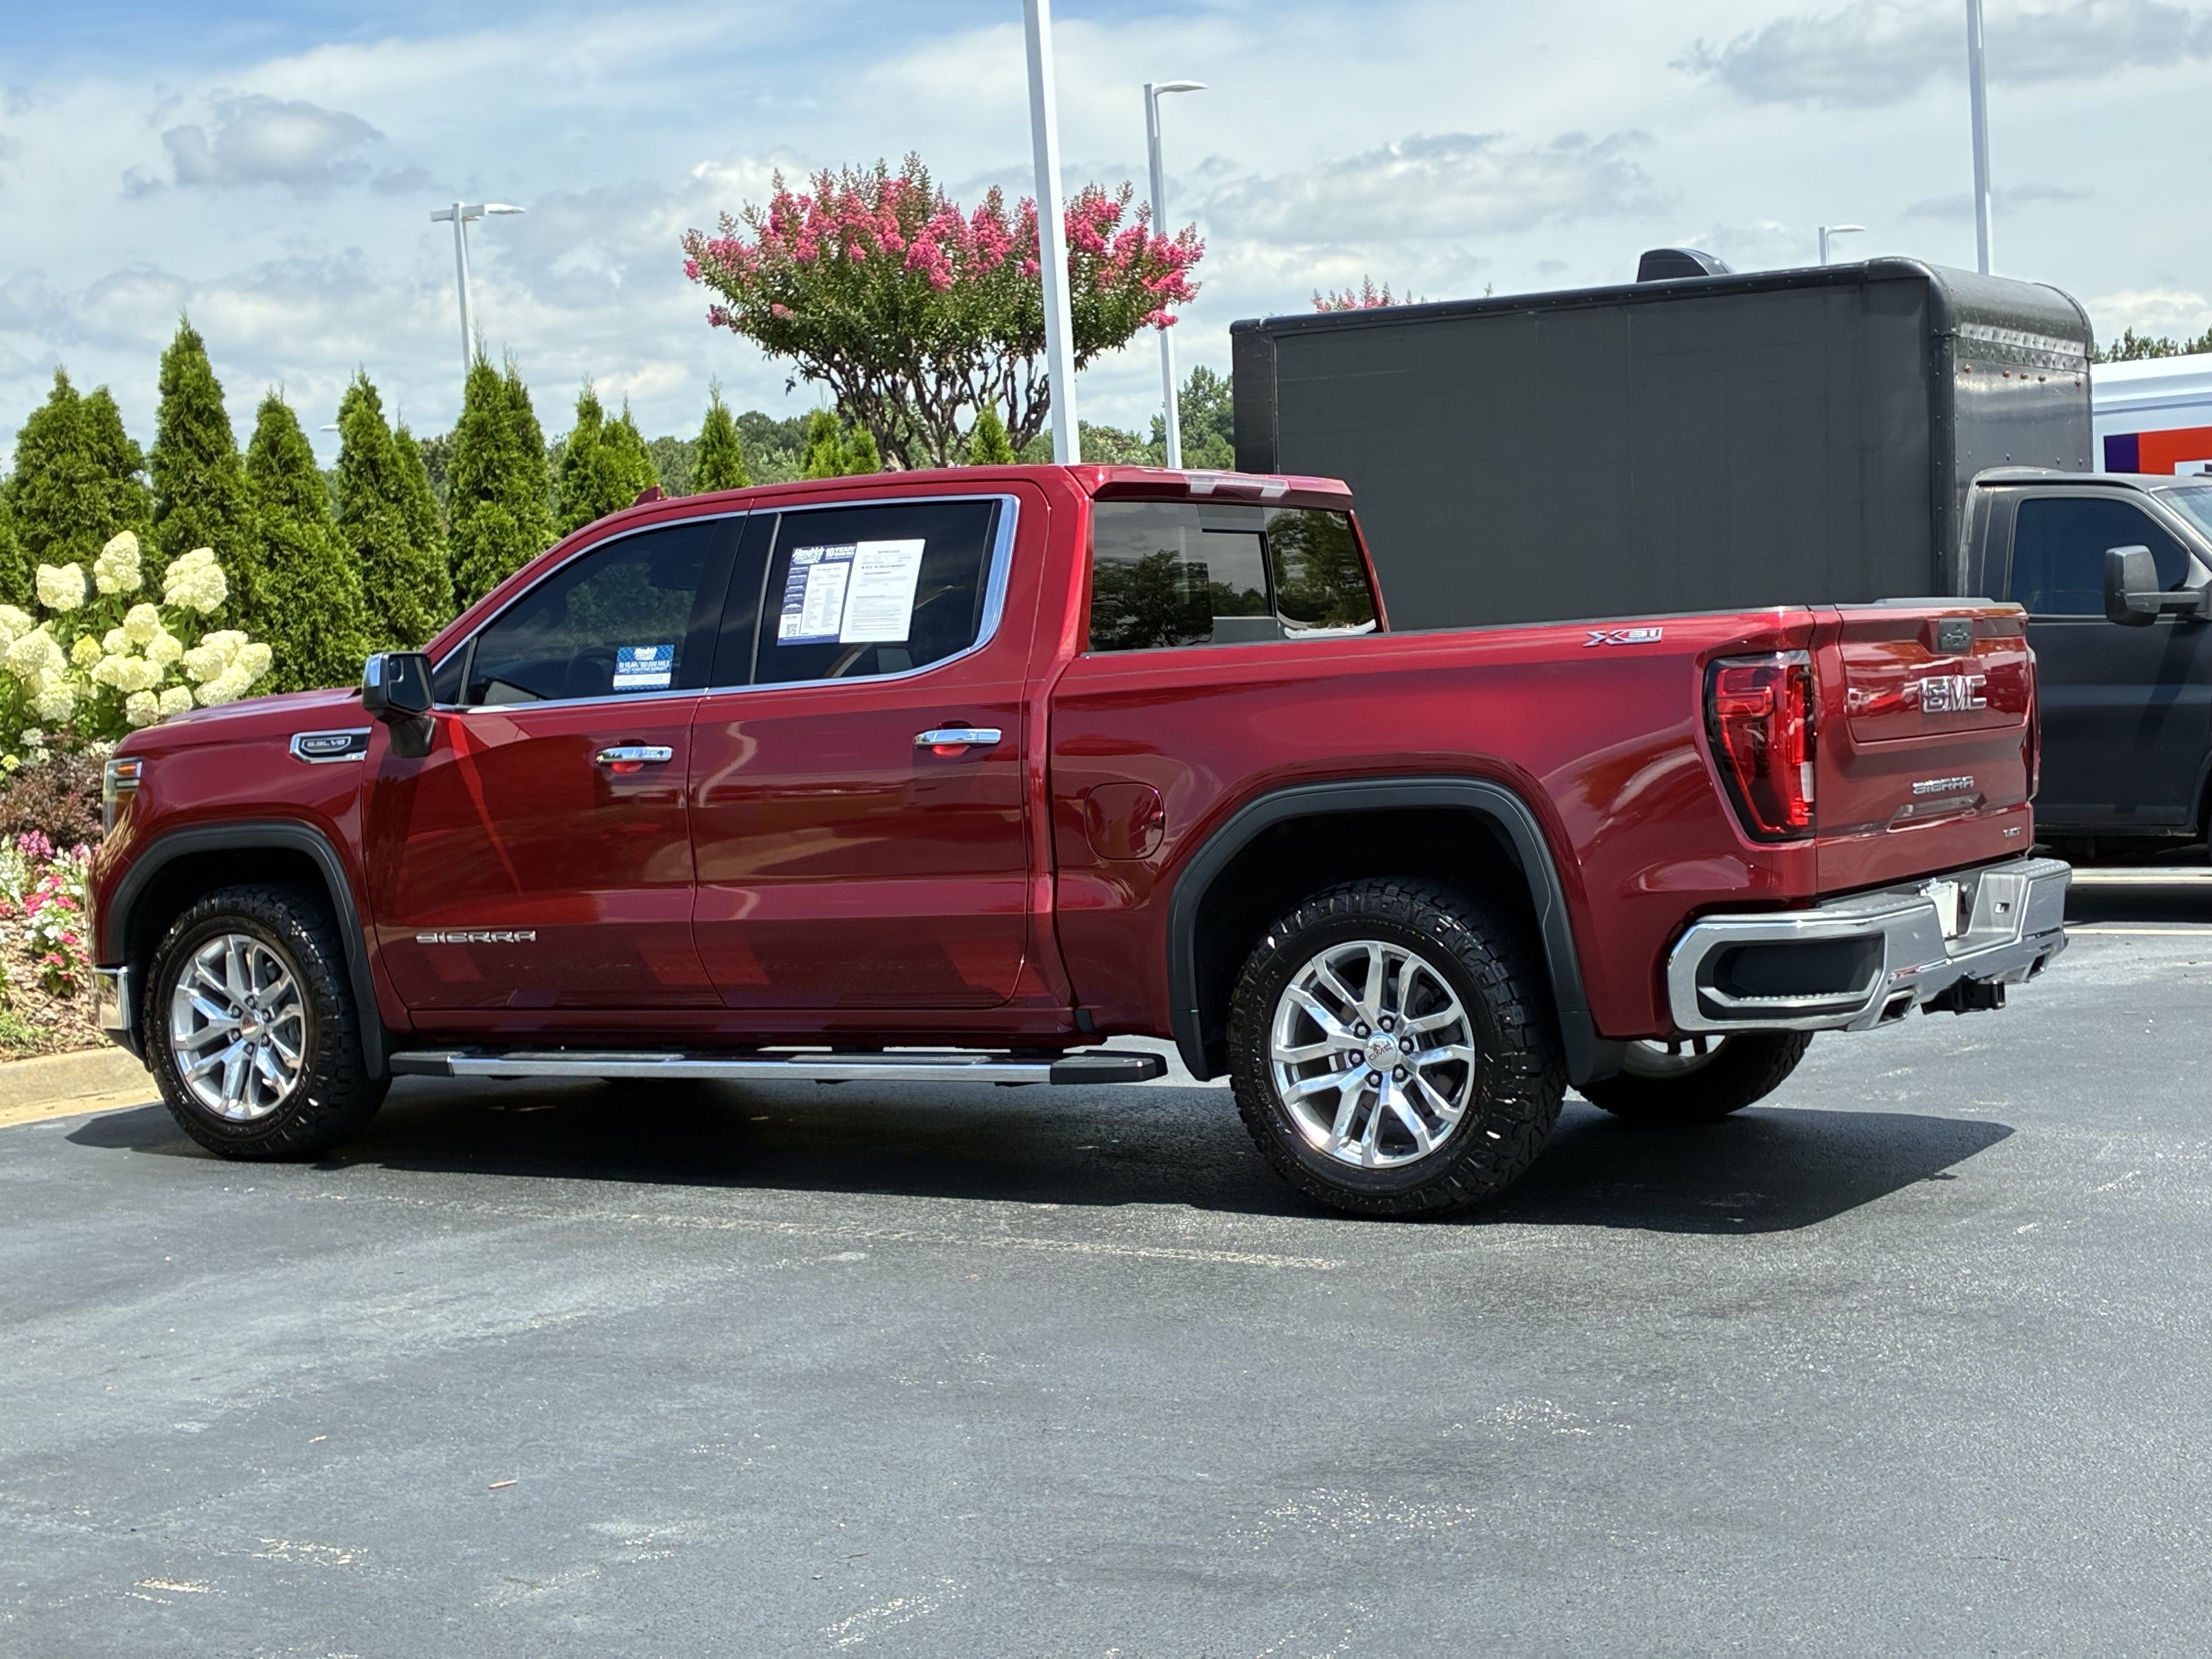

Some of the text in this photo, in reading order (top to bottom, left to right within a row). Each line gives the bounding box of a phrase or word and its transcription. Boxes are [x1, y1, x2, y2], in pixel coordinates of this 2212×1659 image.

[1921, 675, 1987, 713] GMC
[1912, 776, 1974, 795] SIERRA
[416, 931, 536, 944] SIERRA
[1369, 1040, 1394, 1060] GMC
